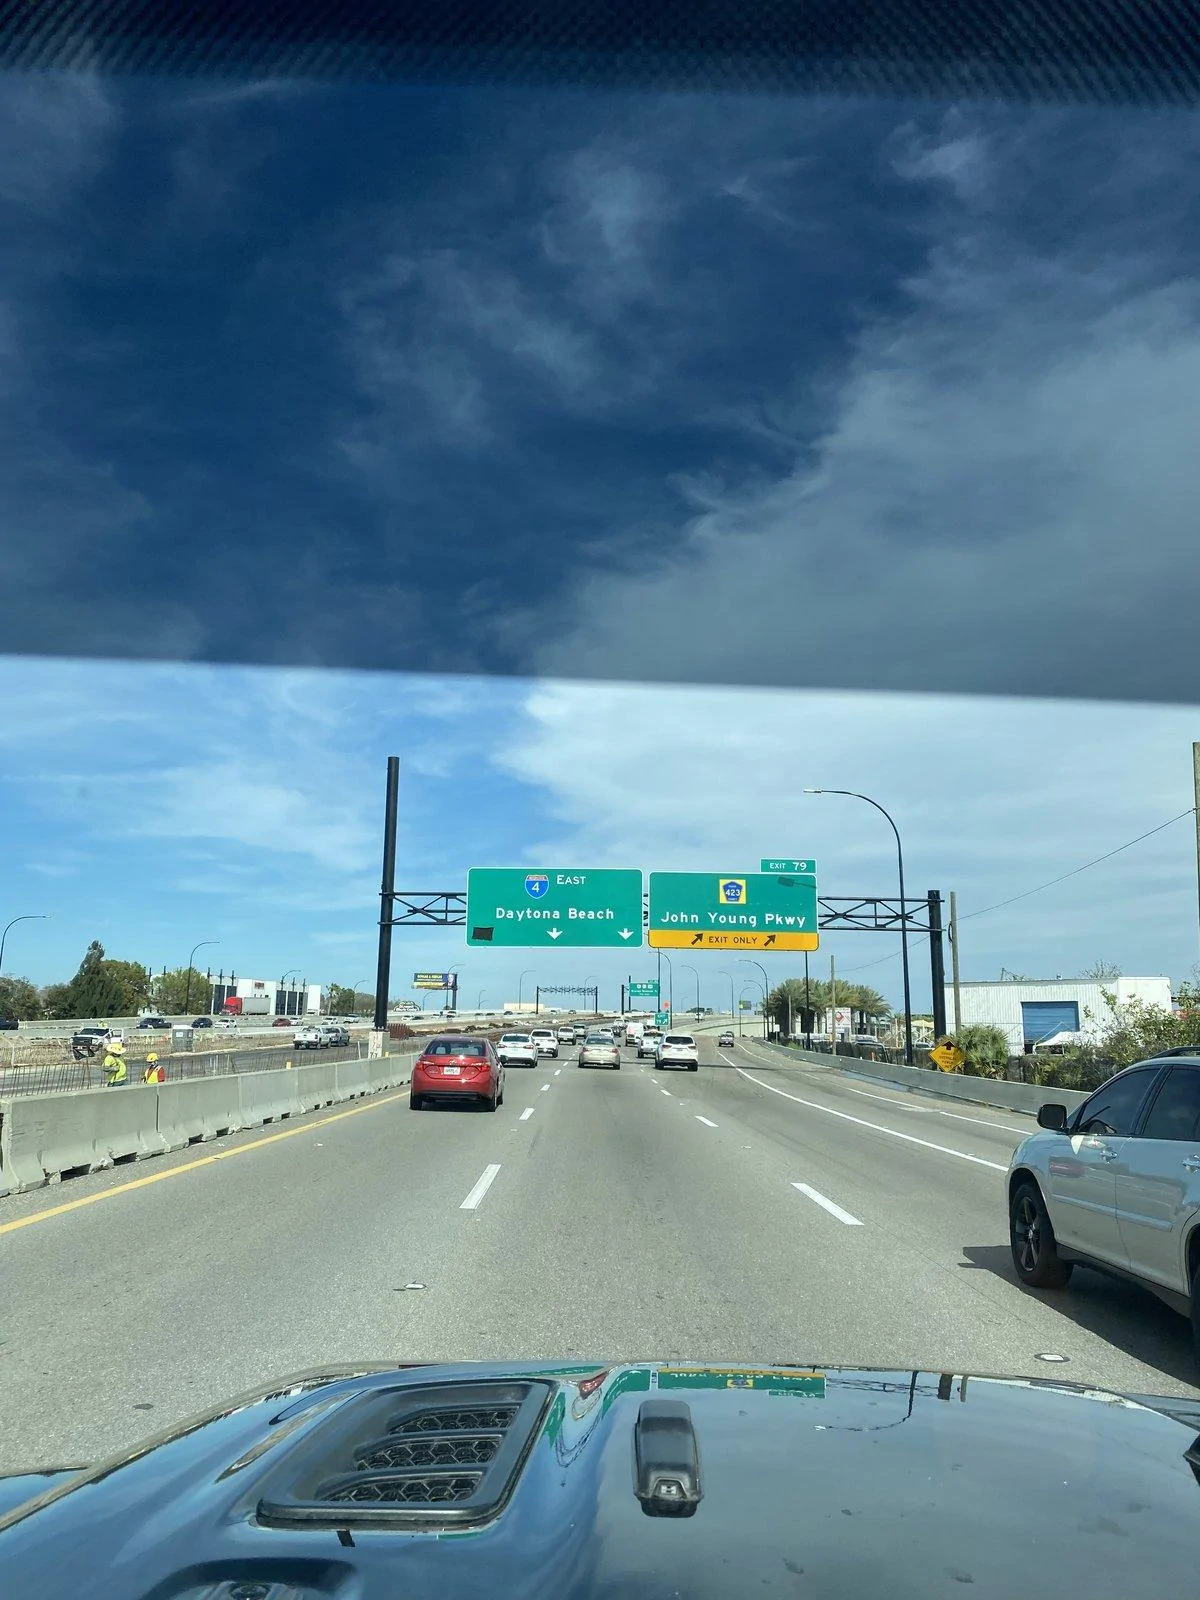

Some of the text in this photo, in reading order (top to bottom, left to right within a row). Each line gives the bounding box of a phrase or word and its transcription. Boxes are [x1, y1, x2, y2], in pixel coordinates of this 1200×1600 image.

[792, 861, 807, 871] 79
[556, 874, 587, 885] EAST
[531, 881, 540, 893] 4
[725, 888, 741, 897] 423
[495, 907, 614, 922] Daytona Beach
[660, 911, 806, 928] John Young Pkwy
[733, 936, 757, 944] ONLY
